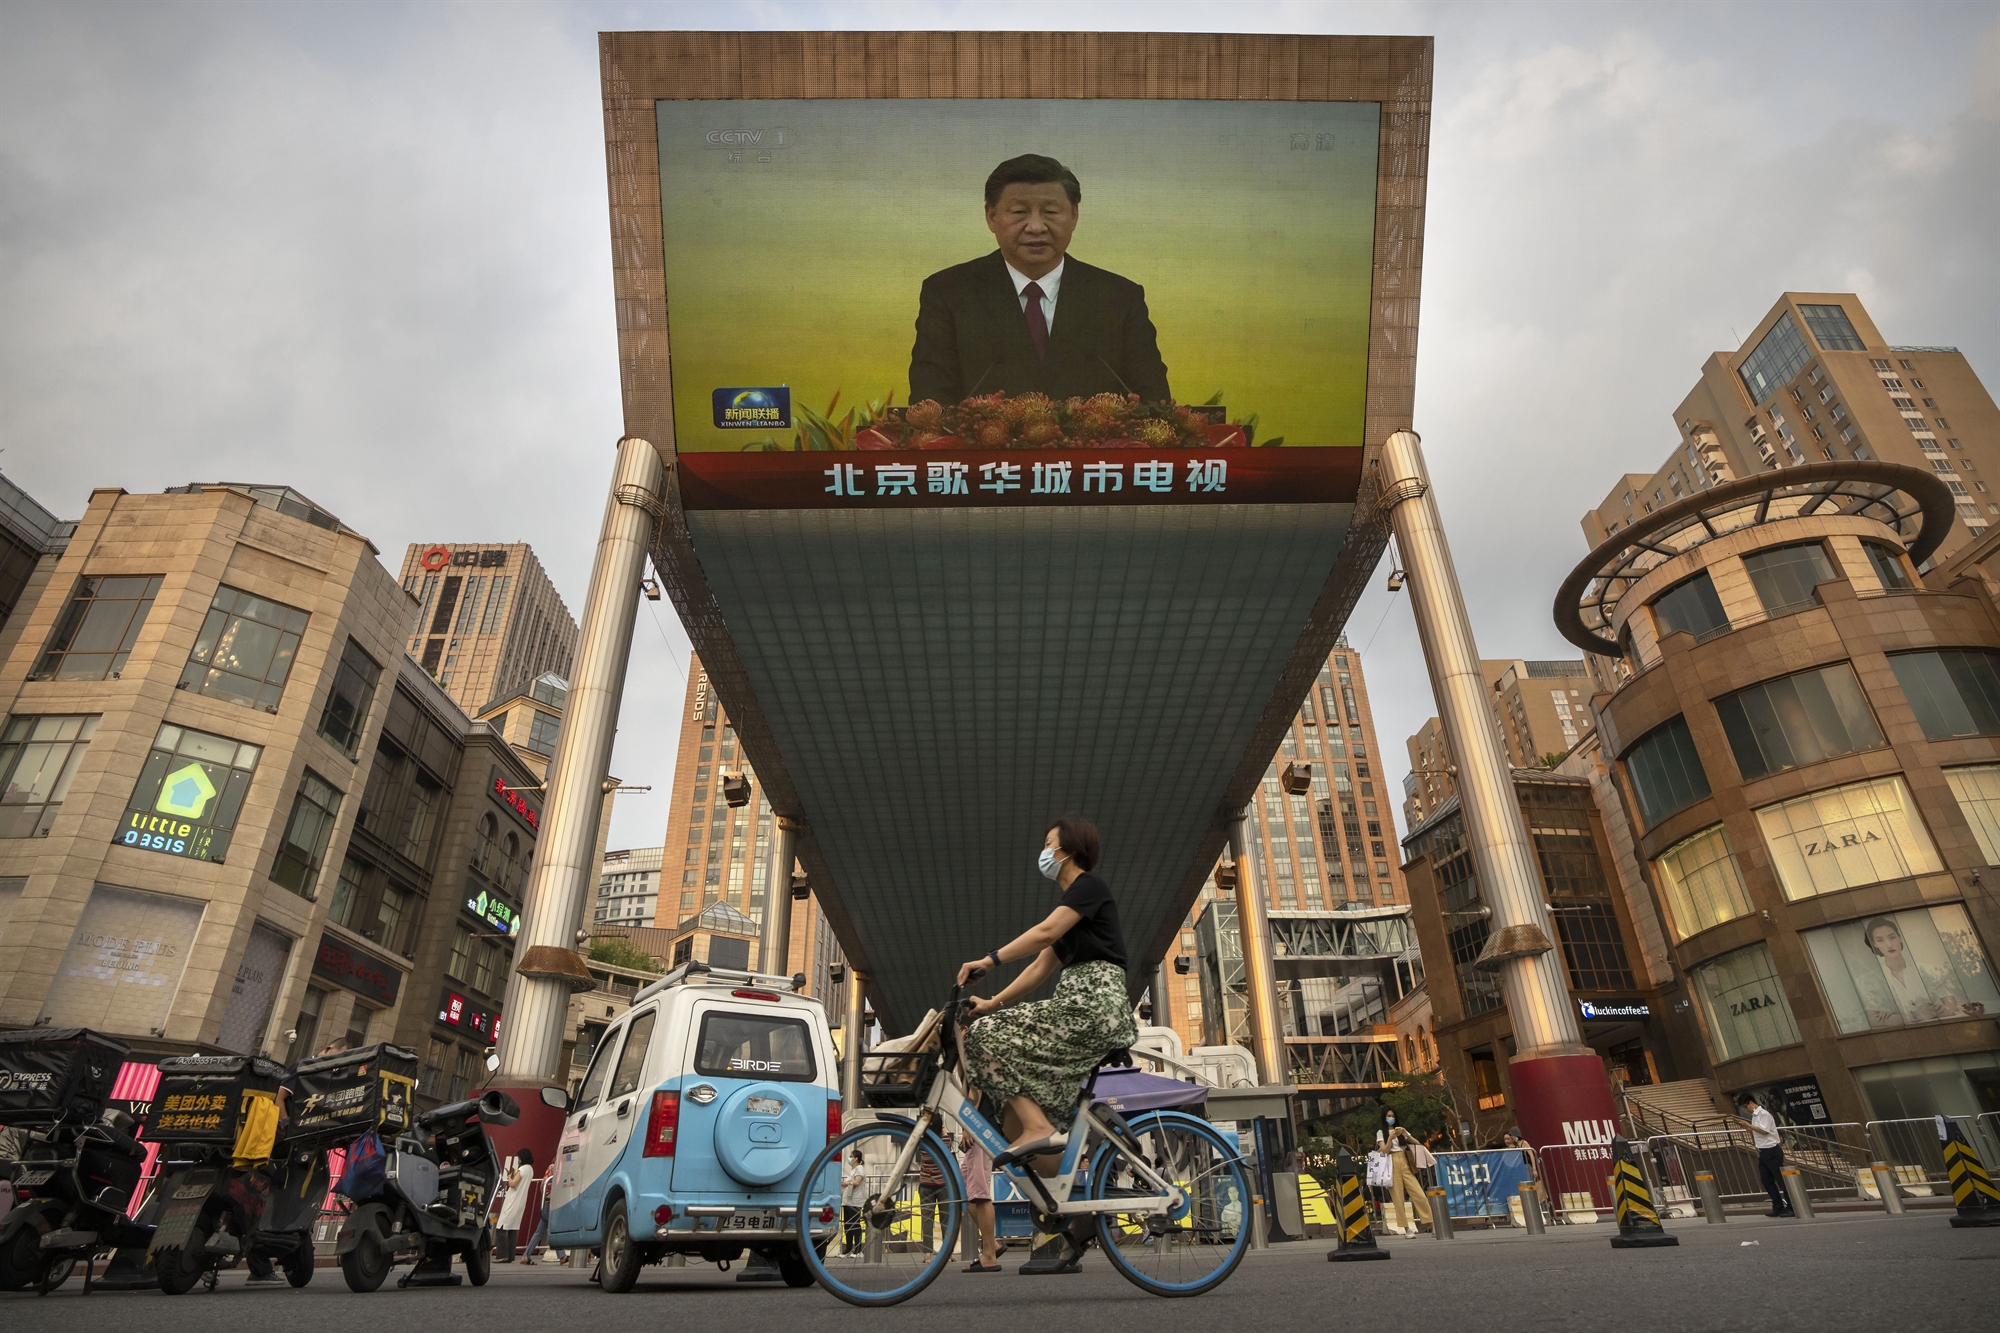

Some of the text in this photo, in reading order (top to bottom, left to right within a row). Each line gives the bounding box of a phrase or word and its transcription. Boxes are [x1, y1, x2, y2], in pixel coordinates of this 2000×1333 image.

[706, 129, 764, 145] CCTV
[1290, 133, 1336, 151] 高清
[724, 407, 780, 421] 新闻联播
[824, 459, 1228, 496] 北京歌华城市电视
[452, 550, 507, 568] 中骏
[131, 812, 191, 837] little
[124, 830, 185, 853] oasis
[1805, 830, 1882, 857] ZARA
[77, 933, 176, 957] MODE PLUS
[102, 959, 140, 971] BEIJING
[1594, 1005, 1641, 1016] luckincoffee
[1730, 994, 1776, 1017] ZARA
[731, 1058, 782, 1072] BIRDIE
[13, 1072, 52, 1082] EXPRESS
[163, 1095, 227, 1111] 美团外卖
[157, 1114, 221, 1130] 送花也快
[1562, 1119, 1616, 1146] MUJI
[1447, 1163, 1491, 1186] 出口
[1464, 1189, 1479, 1197] Ext
